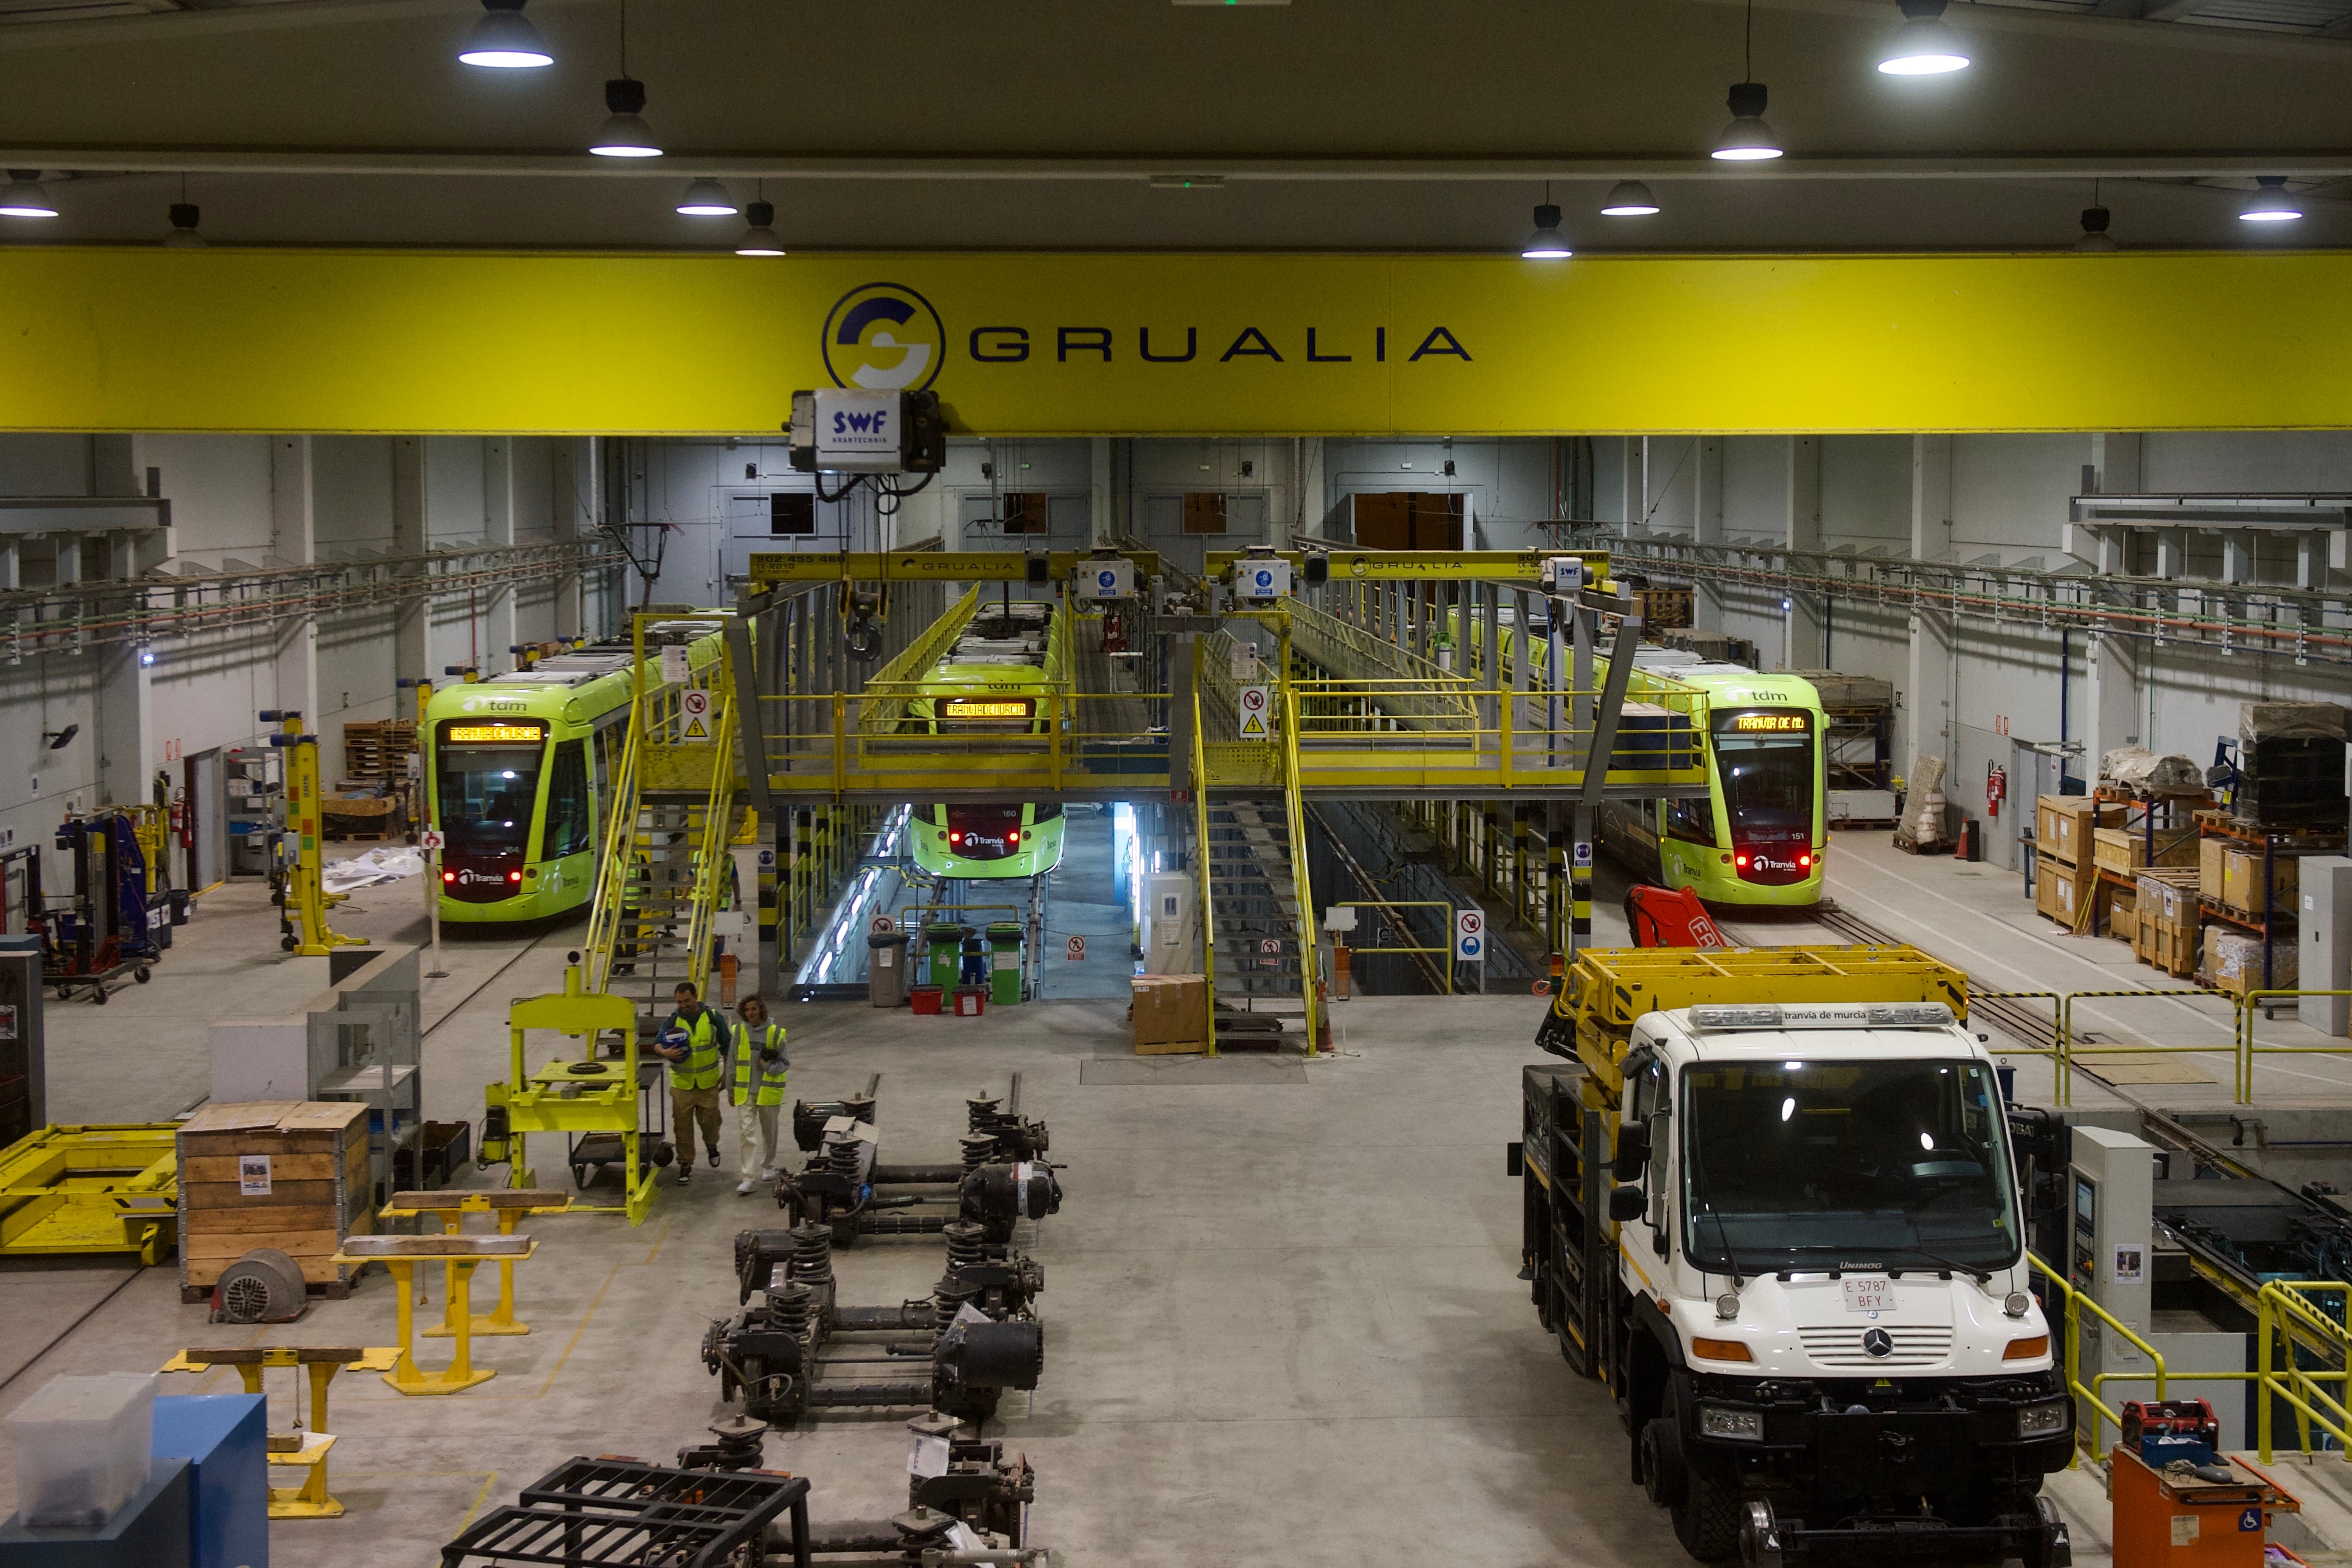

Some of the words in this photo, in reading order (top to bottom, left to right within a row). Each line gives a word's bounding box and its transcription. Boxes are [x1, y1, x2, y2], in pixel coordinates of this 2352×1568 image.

[970, 326, 1473, 362] GRUALIA
[833, 410, 886, 434] SWF
[1373, 562, 1463, 571] GRUALIA
[1751, 690, 1787, 701] tdm
[489, 700, 527, 711] tdm
[1778, 717, 1791, 729] DE
[1785, 1011, 1816, 1019] tranvía
[1820, 1011, 1831, 1019] de
[1834, 1011, 1866, 1019] murcia
[1846, 1281, 1853, 1292] E
[1858, 1281, 1886, 1292] 5787
[1858, 1295, 1880, 1307] BFY
